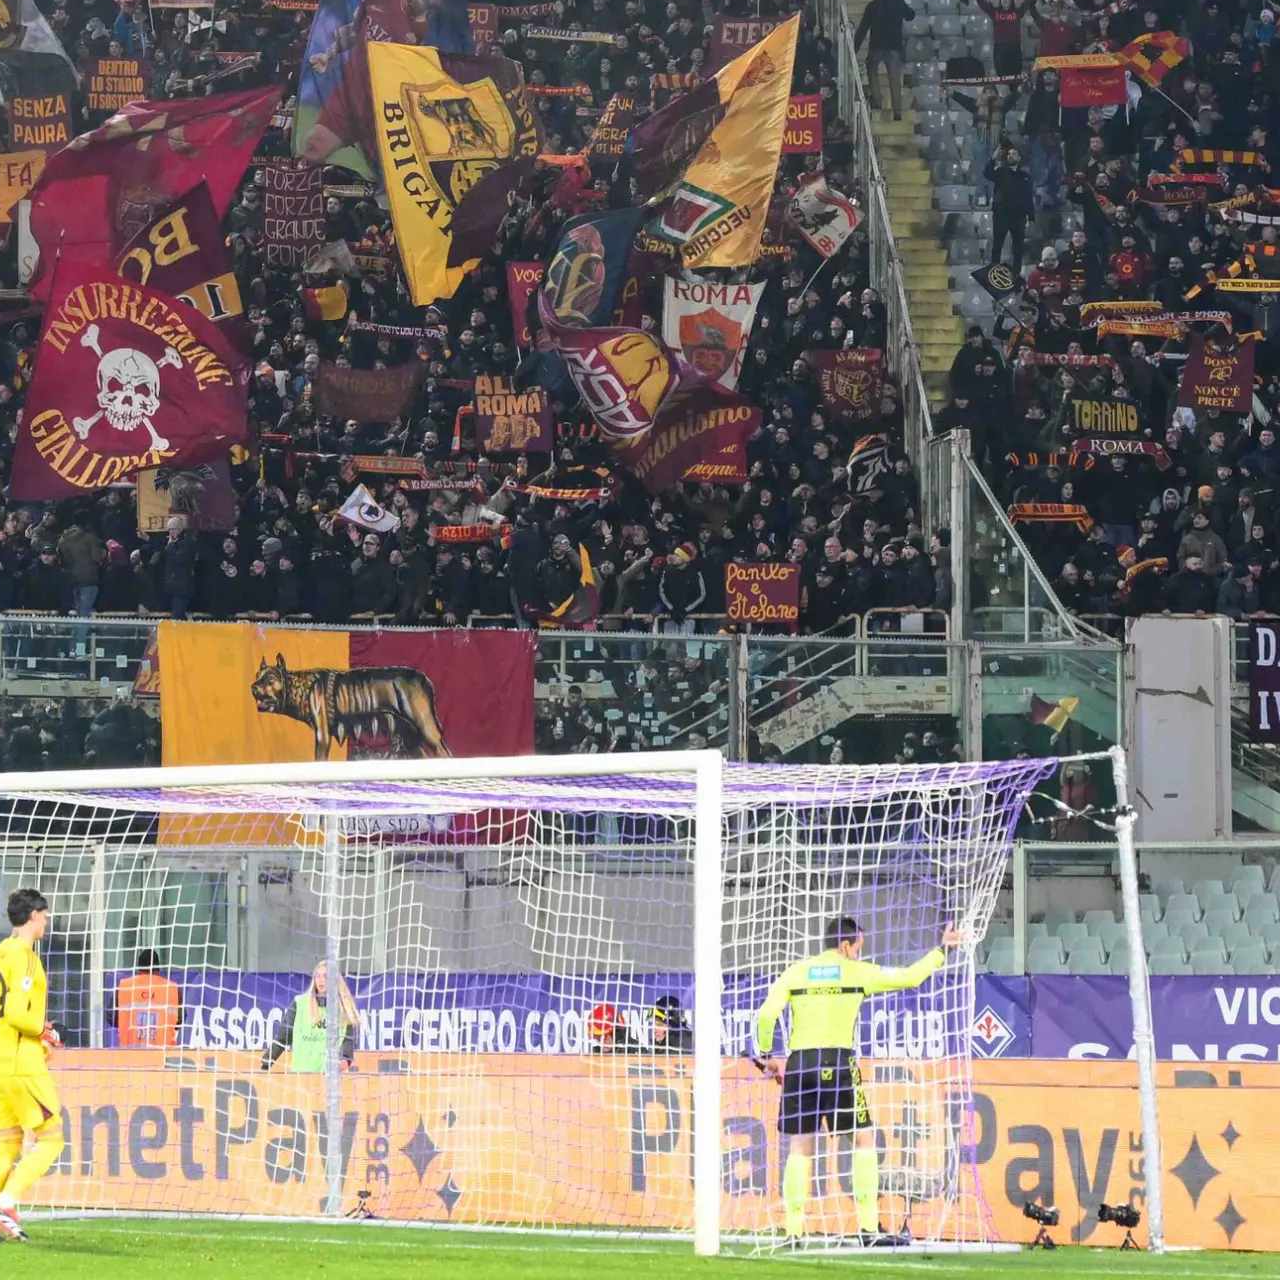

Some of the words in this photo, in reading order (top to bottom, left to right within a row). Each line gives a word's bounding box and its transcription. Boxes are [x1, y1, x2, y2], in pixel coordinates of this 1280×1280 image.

[98, 59, 138, 76] DENTRO
[91, 76, 103, 93] LO
[105, 76, 144, 93] STADIO
[13, 99, 67, 119] SENZA
[13, 122, 68, 145] PAURA
[265, 166, 324, 192] FORZA
[382, 99, 454, 239] BRIGAT
[265, 193, 324, 217] FORZA
[264, 218, 326, 241] GRANDE
[672, 282, 752, 307] ROMA
[42, 280, 234, 391] INSURREZIONE
[1194, 385, 1219, 397] NON
[1197, 396, 1236, 408] PRETE
[478, 391, 542, 417] ROMA
[1090, 439, 1146, 454] ROMA
[750, 583, 760, 594] e
[727, 593, 798, 622] Stefano
[404, 1008, 517, 1054] CENTRO
[871, 1010, 945, 1058] CLUB
[364, 1111, 391, 1186] 365
